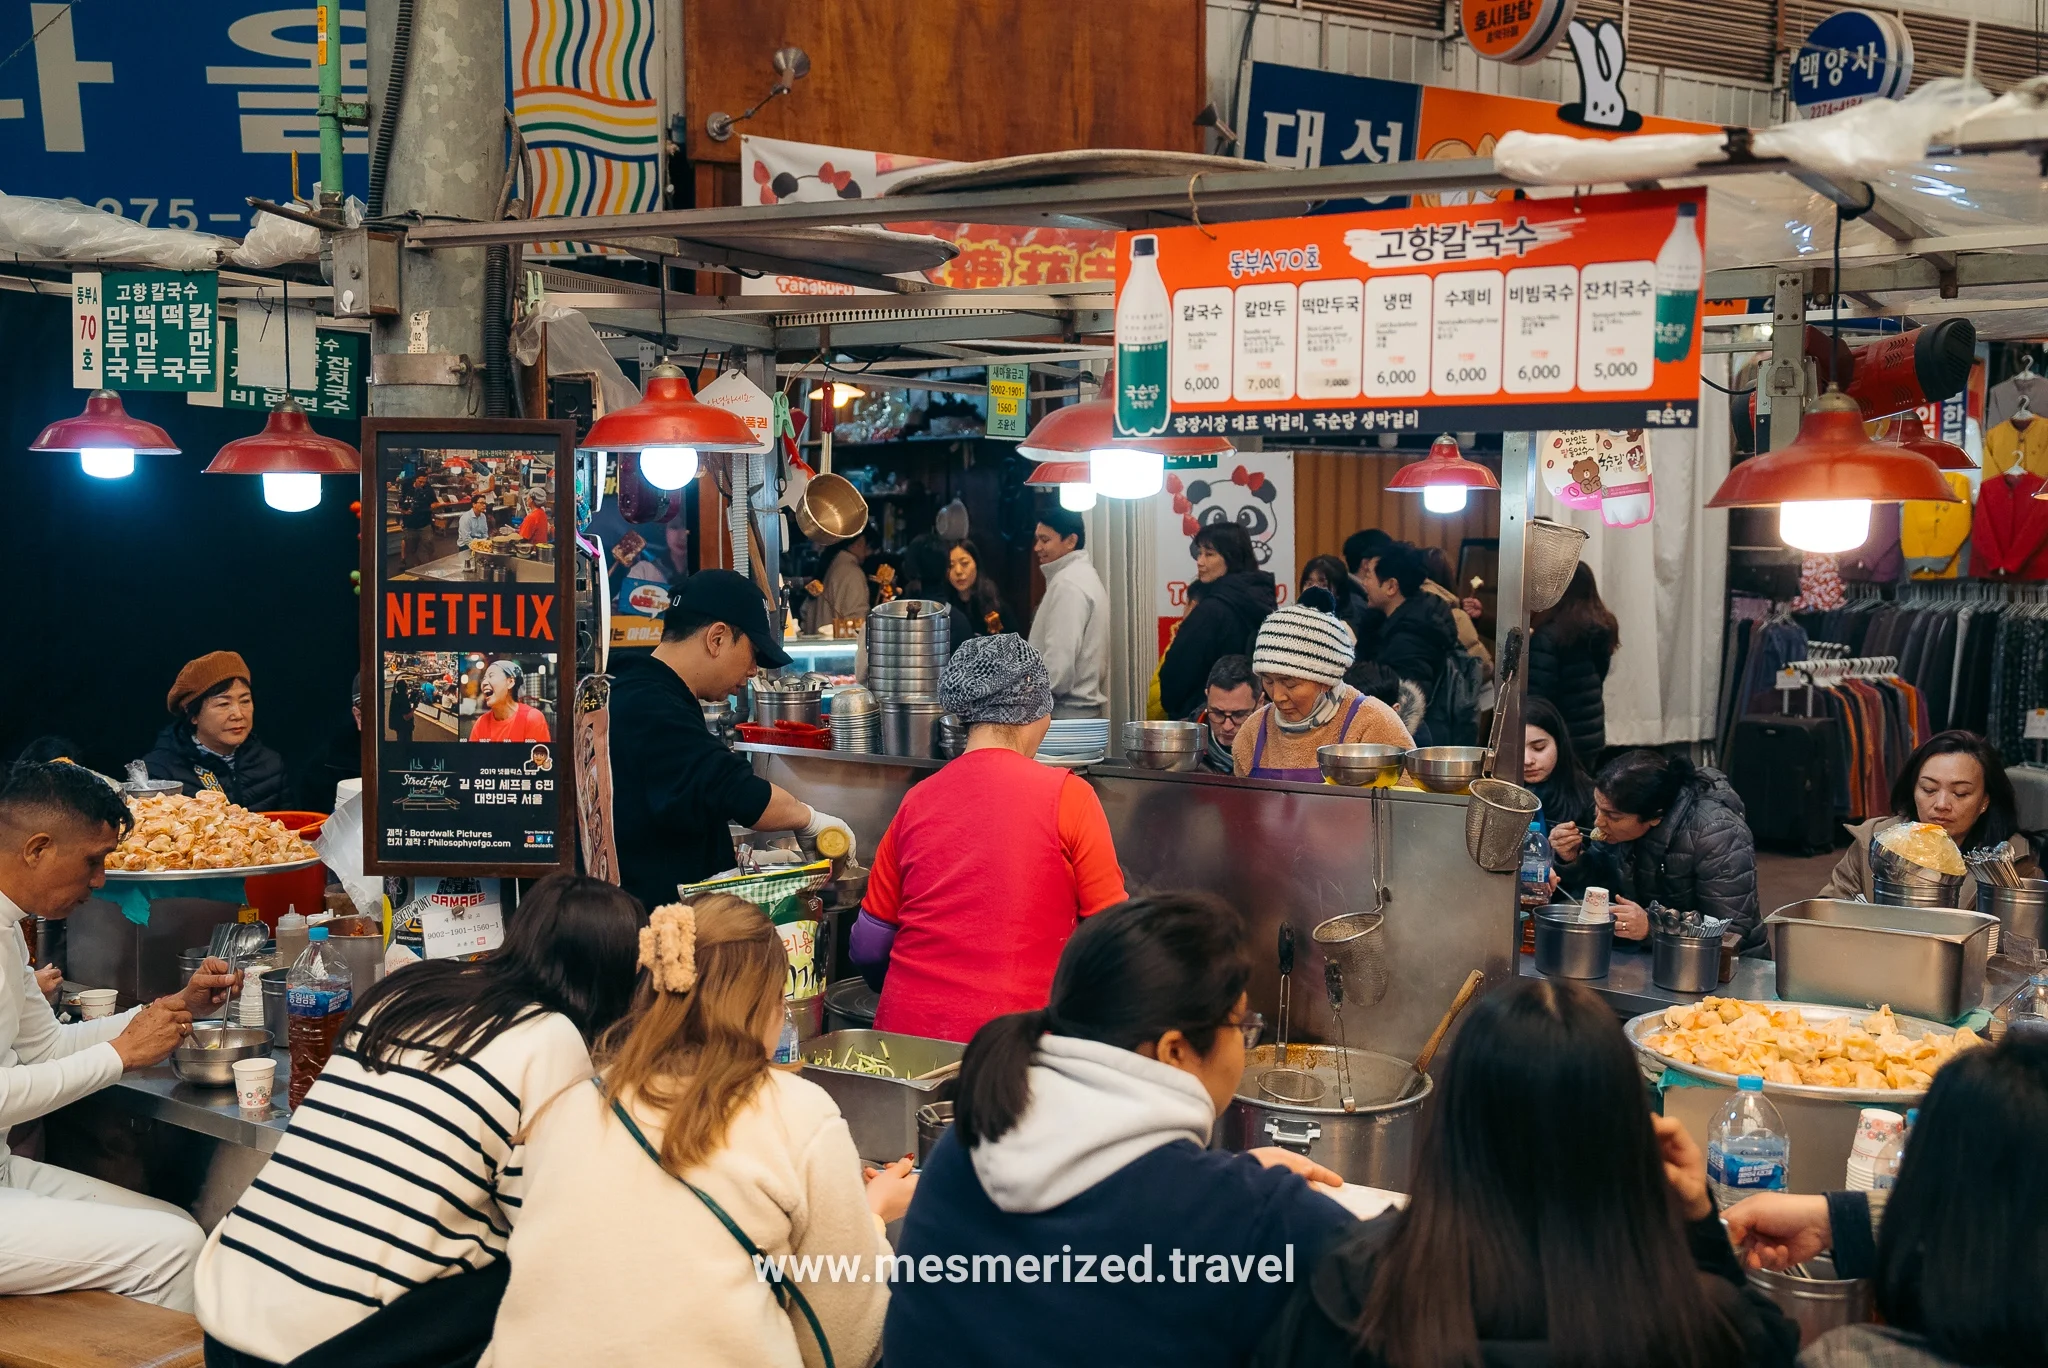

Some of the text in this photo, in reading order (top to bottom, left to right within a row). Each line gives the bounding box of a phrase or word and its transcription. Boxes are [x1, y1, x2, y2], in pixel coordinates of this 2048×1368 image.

[1800, 41, 1879, 89] 백양사
[1376, 219, 1538, 262] 고향칼국수
[1230, 246, 1320, 276] 동부A70호
[77, 286, 98, 304] 동부A
[116, 282, 198, 301] 고향 칼국수
[776, 276, 854, 296] Tanghuru
[1509, 284, 1574, 304] 비빔국수
[1584, 279, 1652, 301] 잔치국수
[1302, 295, 1360, 314] 떡만두국
[1384, 293, 1412, 311] 냉면
[1445, 287, 1491, 307] 수제비
[1183, 303, 1223, 321] 칼국수
[1244, 300, 1287, 318] 칼만두
[80, 315, 97, 340] 70
[105, 305, 130, 383] 만두국
[134, 304, 158, 383] 떡만두
[187, 303, 212, 383] 칼만두
[82, 348, 93, 370] 호
[993, 366, 1024, 380] 새마을금고
[1377, 369, 1416, 387] 6,000
[1446, 366, 1487, 384] 6,000
[1518, 364, 1560, 383] 6,000
[1594, 361, 1638, 380] 5,000
[991, 385, 1025, 397] 9002-1901-
[1125, 384, 1160, 400] 국순당
[1184, 376, 1220, 394] 6,000
[1247, 378, 1281, 392] 7,000
[997, 403, 1017, 414] 1560-1
[742, 415, 768, 429] 품권
[997, 420, 1016, 431] 조윤선
[1174, 410, 1419, 433] 광장시장 대표 막걸리, 국순당 생막걸리
[386, 592, 555, 641] NETFLIX
[459, 779, 470, 790] 길
[474, 779, 495, 790] 위의
[535, 779, 554, 791] 6편
[474, 793, 543, 805] 대한민국 서울
[387, 828, 402, 837] 제작
[410, 829, 454, 837] Boardwalk
[456, 829, 493, 838] Pictures
[428, 838, 511, 848] Philosophyofgo.com
[431, 892, 486, 908] DAMAGE
[427, 921, 499, 939] 9002-1901-1560-1
[289, 992, 316, 1006] 동원샘물
